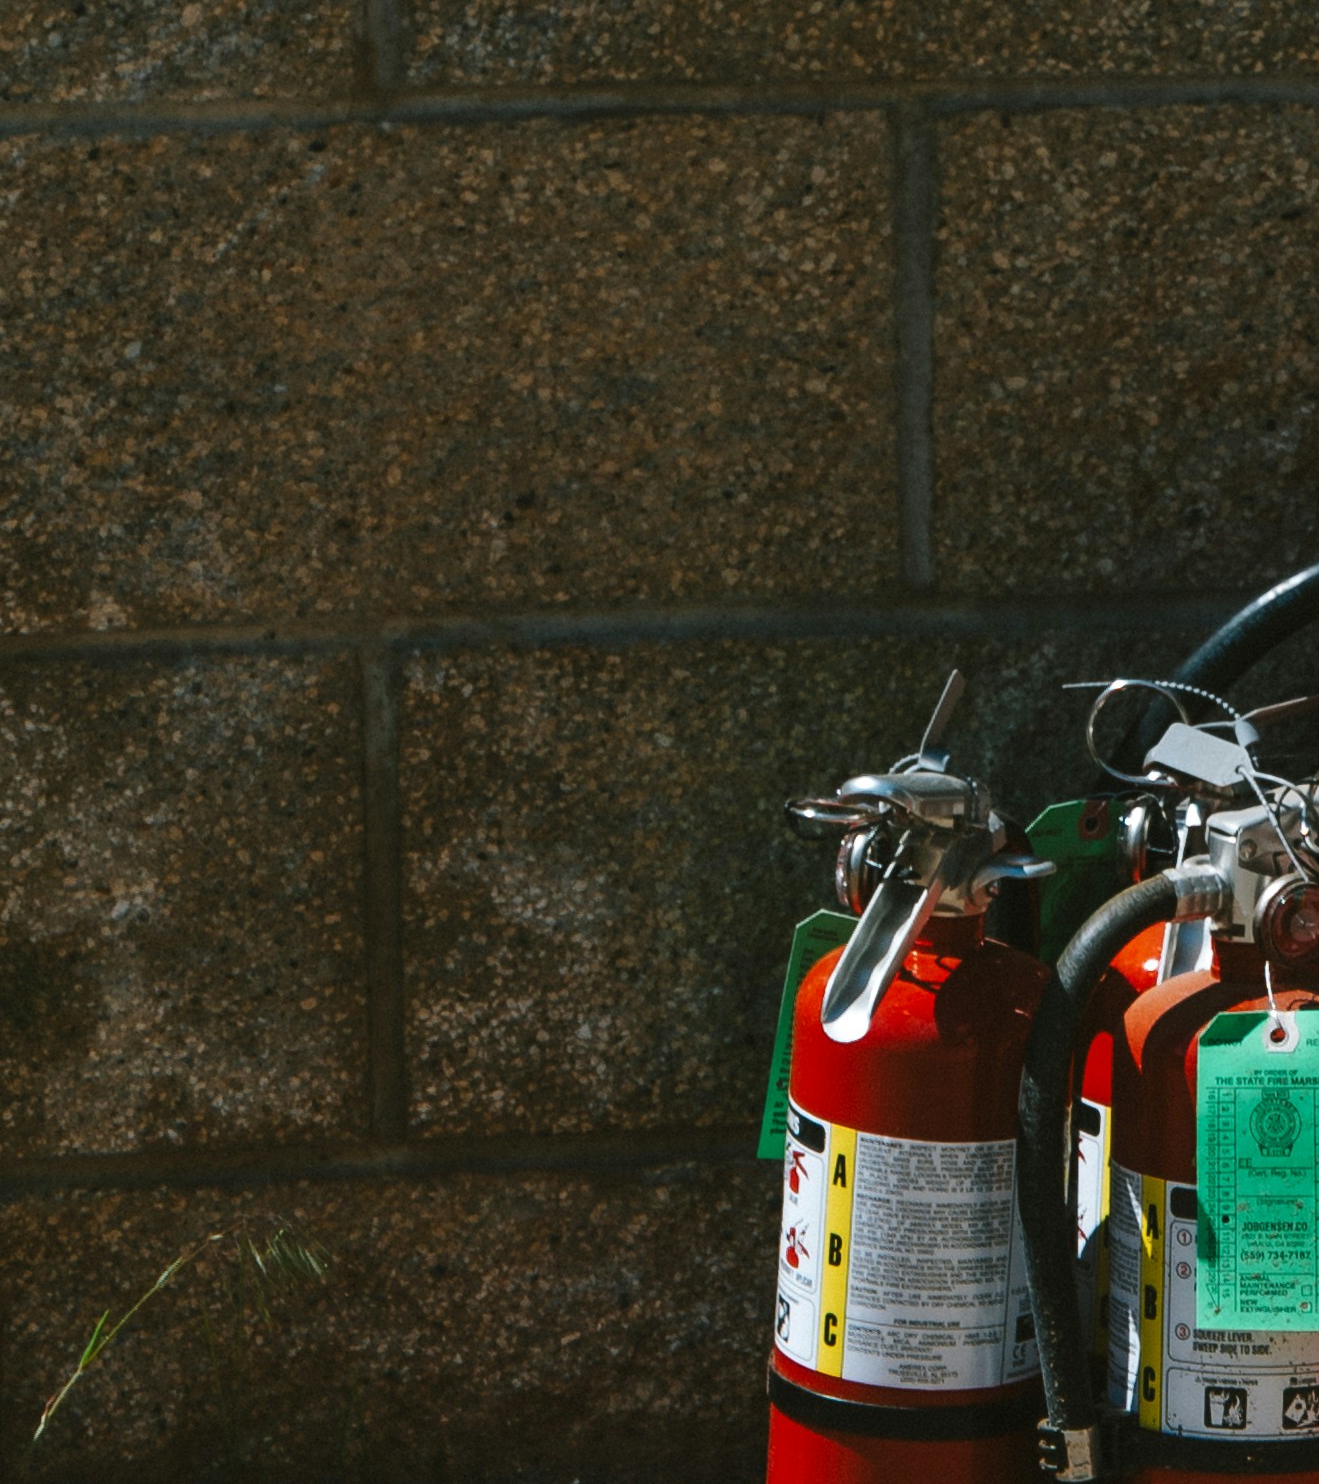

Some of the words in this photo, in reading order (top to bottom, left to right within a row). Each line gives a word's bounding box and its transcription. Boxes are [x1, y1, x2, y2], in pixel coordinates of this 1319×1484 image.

[1215, 1077, 1233, 1085] THE
[1236, 1077, 1264, 1085] STATE
[1267, 1077, 1289, 1085] FIRE
[832, 1154, 846, 1188] A
[828, 1232, 842, 1266] B
[824, 1312, 838, 1347] C
[1239, 1344, 1251, 1355] TO
[1252, 1343, 1273, 1356] SIDE.
[1142, 1366, 1156, 1402] C
